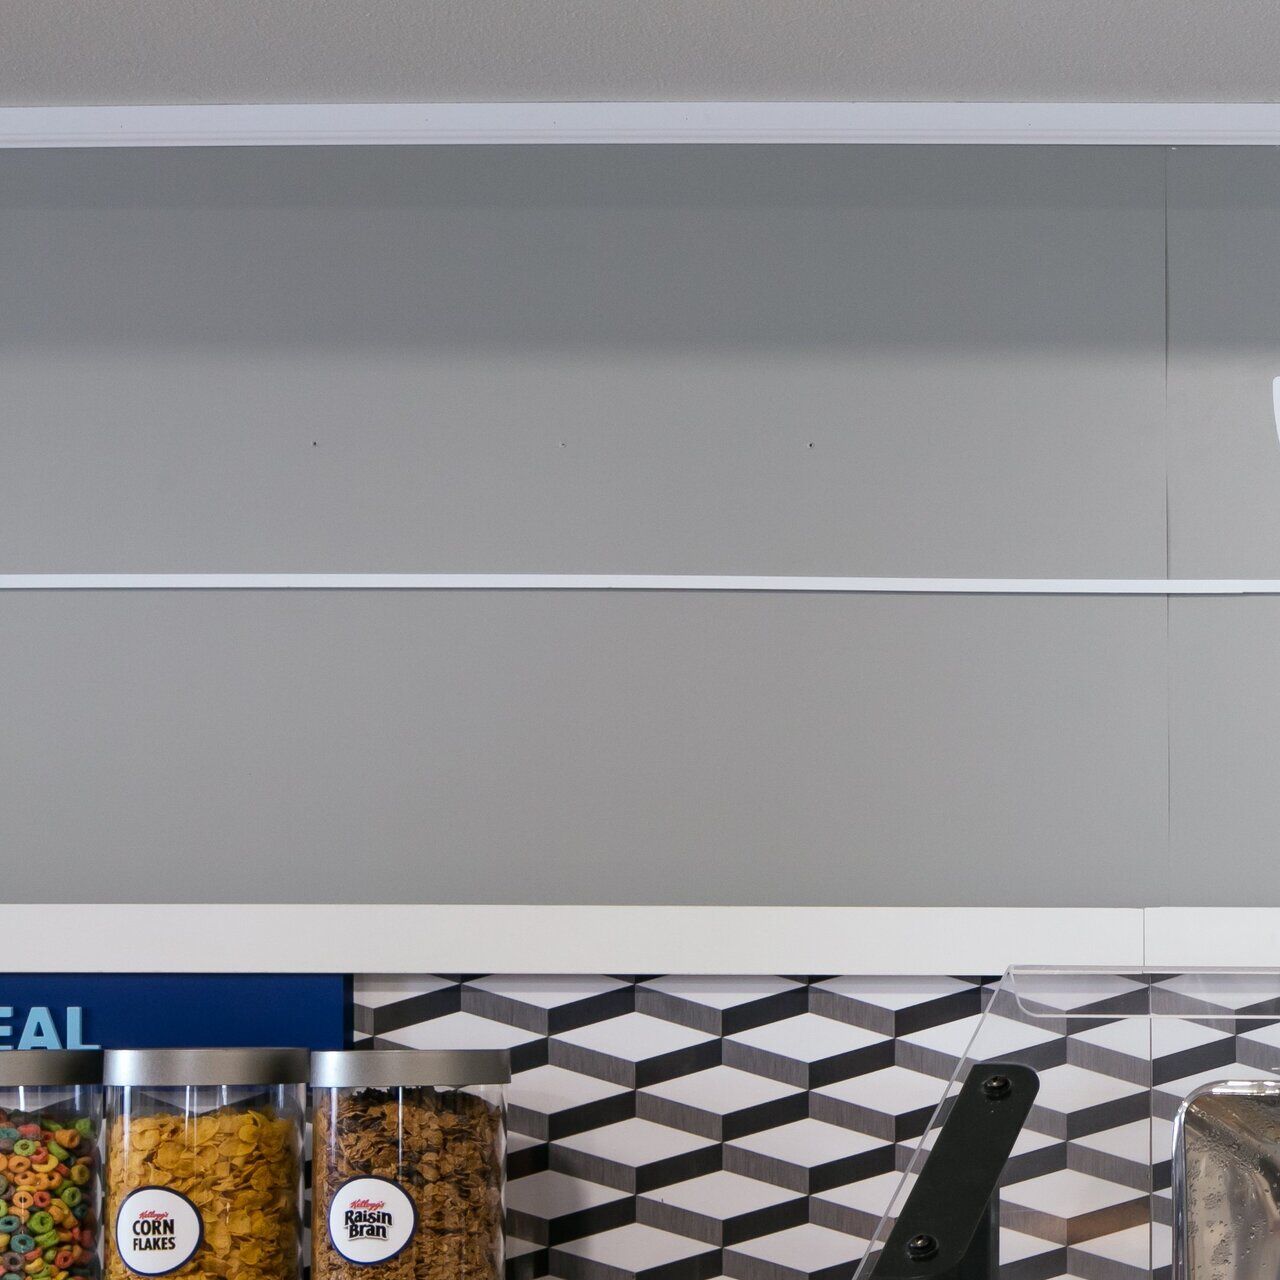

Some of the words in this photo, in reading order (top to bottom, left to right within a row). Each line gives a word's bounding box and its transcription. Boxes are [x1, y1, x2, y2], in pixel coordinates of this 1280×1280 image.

[350, 1199, 385, 1211] Kellogg's
[344, 1210, 393, 1226] Raisin
[132, 1219, 175, 1236] CORN
[348, 1224, 387, 1239] Bran
[133, 1236, 176, 1251] FLAKES
